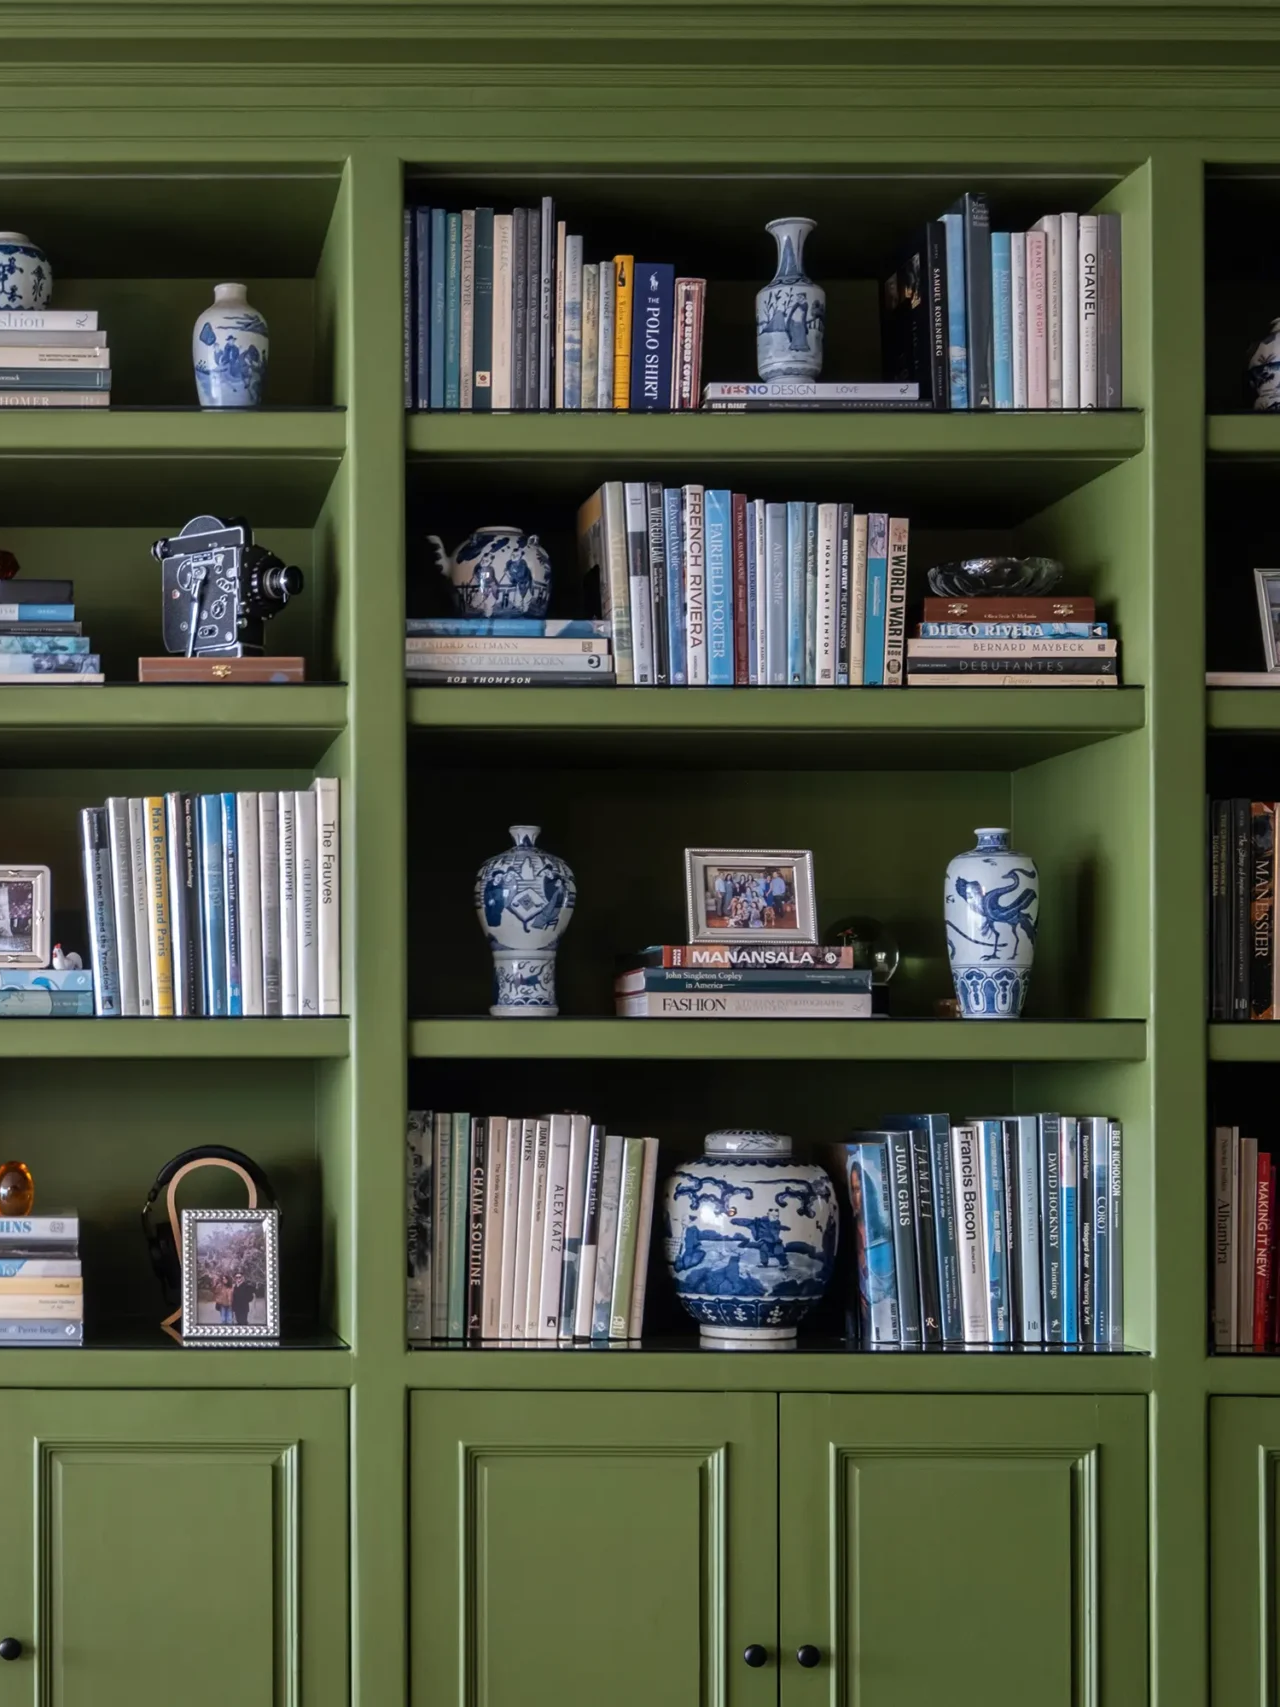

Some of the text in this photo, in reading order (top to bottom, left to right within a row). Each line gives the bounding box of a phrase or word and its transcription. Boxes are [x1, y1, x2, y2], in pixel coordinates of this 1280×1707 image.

[463, 223, 473, 307] RAPHAEL SOYER
[647, 297, 660, 305] THE
[933, 267, 942, 303] SAMUEL
[1035, 272, 1043, 301] LLOYD
[1084, 252, 1096, 321] CHANEL
[934, 305, 943, 357] ROSENBERG
[1035, 303, 1044, 339] WRIGHT
[644, 306, 661, 400] POLO SHIRT
[682, 300, 694, 399] 1000 RECORD COVERS
[770, 384, 816, 395] DESIGN
[650, 507, 663, 544] WIFREDO
[651, 546, 664, 564] LAM
[824, 538, 832, 579] THOMAS
[841, 538, 849, 567] MILTON
[892, 544, 907, 553] THE
[689, 492, 703, 649] FRENCH RIVIERA
[841, 567, 849, 591] AVERY
[710, 522, 725, 659] FAIRFIELD PORTER
[887, 554, 907, 649] WORLD WAR II
[840, 602, 848, 617] LATE
[840, 617, 848, 649] PAINTINGS
[928, 624, 1044, 638] DIEGO RIVERA
[972, 643, 1026, 652] BERNARD
[1032, 643, 1085, 652] MAYBECK
[446, 676, 532, 685] BOB THOMPSON
[959, 660, 1064, 672] DEBUTANTES
[135, 837, 144, 873] MORGAN
[186, 858, 194, 888] Anthology
[226, 829, 236, 900] Judith Rothschild
[283, 809, 294, 902] EDWARD HOPPER
[322, 820, 336, 905] The Fauves
[151, 807, 168, 957] Max Beckmann and Paris
[96, 901, 106, 933] Beyond
[303, 858, 313, 948] GUILLERMO ROUX
[1254, 860, 1270, 958] MANESSIER
[99, 934, 108, 948] the
[692, 950, 814, 964] MANANSALA
[100, 950, 110, 991] Tradition
[665, 972, 743, 982] John Singleton Copley
[685, 981, 724, 989] in America
[662, 998, 727, 1012] FASHION
[537, 1126, 548, 1169] JUAN GRIS
[1082, 1134, 1091, 1161] Reinhold
[1111, 1130, 1121, 1197] BEN NICHOLSON
[493, 1174, 501, 1190] Infinite
[588, 1138, 602, 1216] surrealist prints
[895, 1144, 911, 1226] JUAN GRIS
[914, 1144, 932, 1219] JAMALI
[960, 1130, 977, 1240] Francis Bacon
[1026, 1167, 1035, 1205] MORGAN
[492, 1192, 500, 1207] World
[621, 1165, 637, 1234] Maria Segers
[1096, 1195, 1107, 1236] COROT
[470, 1166, 485, 1287] CHAIM SOUTINE
[550, 1184, 565, 1253] ALEX KATZ
[1047, 1152, 1060, 1300] DAVID HOCKNEY Paintings
[1217, 1198, 1231, 1265] Alhambra
[1256, 1181, 1269, 1277] MAKING IT NEW
[1082, 1222, 1091, 1252] Hildegard
[1083, 1253, 1091, 1268] Auer
[1082, 1280, 1091, 1306] Yearning
[1083, 1306, 1092, 1315] for
[1083, 1315, 1092, 1325] Art
